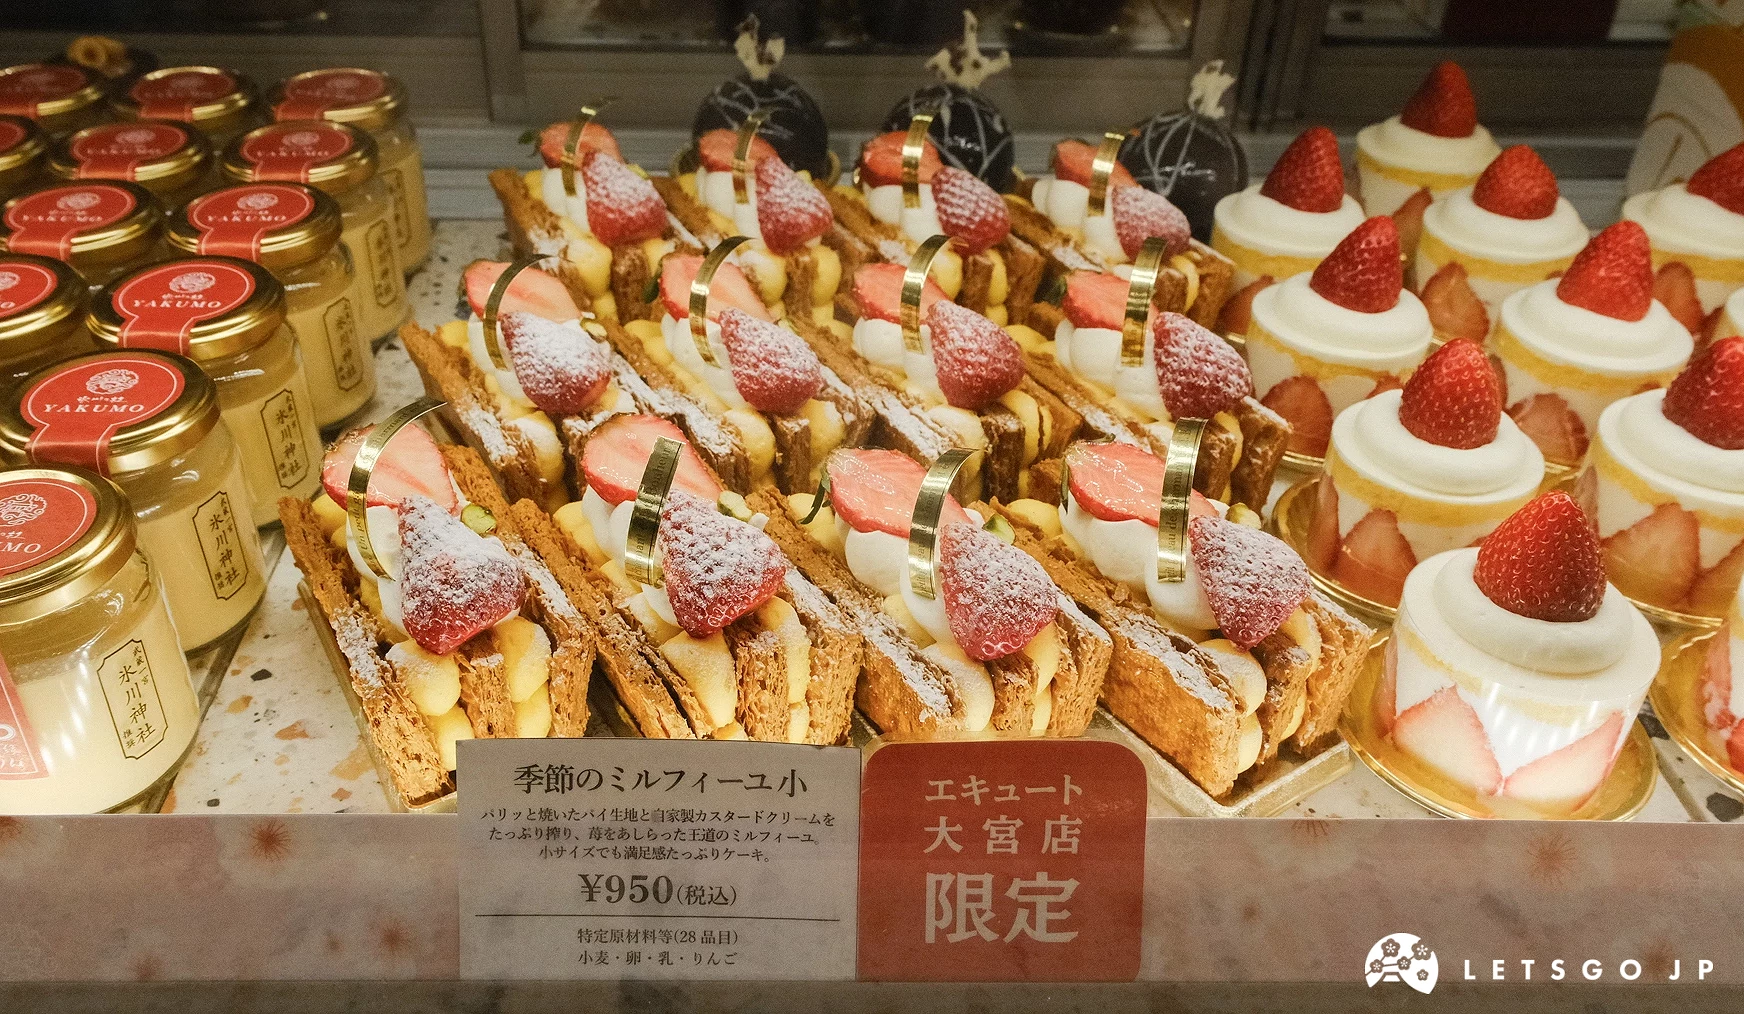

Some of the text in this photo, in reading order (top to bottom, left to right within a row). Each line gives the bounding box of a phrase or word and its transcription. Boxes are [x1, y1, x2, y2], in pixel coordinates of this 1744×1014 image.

[133, 300, 222, 308] YAKUMO
[43, 403, 145, 413] YAKUMO
[209, 513, 240, 586] 氷川神社
[118, 665, 156, 743] 氷川神社
[513, 763, 808, 798] 季節のミルフィーユ小
[924, 774, 1083, 806] エキュート
[923, 814, 1083, 855] 大宮店
[538, 845, 770, 863] 小サイズでも満足感たっぷりケーキ。
[924, 871, 1081, 944] 限定
